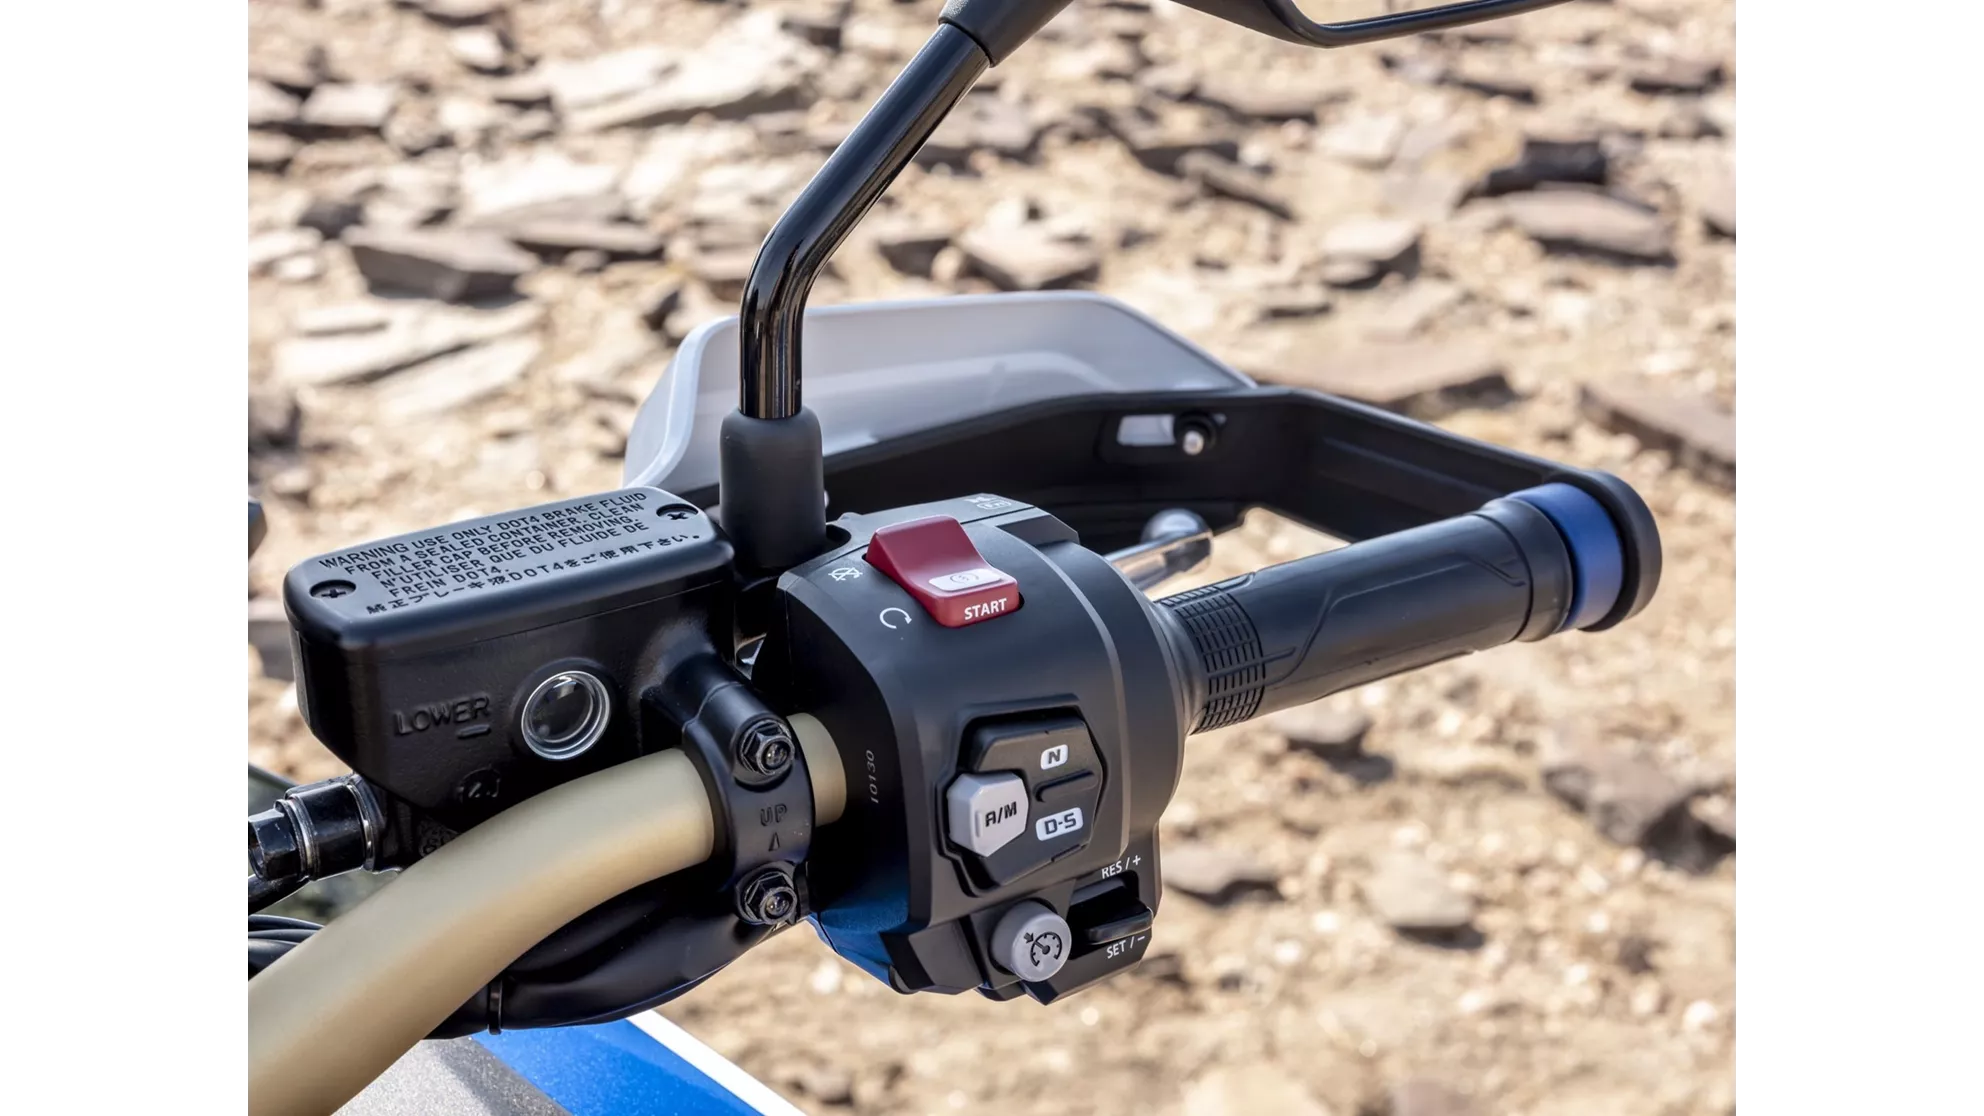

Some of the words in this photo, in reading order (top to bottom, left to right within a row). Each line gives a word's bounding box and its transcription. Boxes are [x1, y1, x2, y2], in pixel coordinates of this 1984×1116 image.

[319, 543, 409, 568] WARNING
[412, 535, 448, 549] USE
[452, 525, 492, 540] ONLY
[497, 515, 540, 530] DOT4
[542, 503, 598, 520] BRAKE
[599, 492, 647, 508] FLUID
[344, 558, 396, 575] FROM
[400, 555, 412, 563] A
[415, 538, 485, 559] SEALED
[589, 503, 645, 520] CLEAN
[371, 560, 437, 579] FILLER
[440, 551, 473, 564] CAP
[477, 534, 547, 555] BEFORE
[548, 515, 639, 540] REMOVING.
[380, 560, 485, 589] N'UTILISER
[489, 549, 527, 563] QUE
[529, 543, 555, 554] DU
[558, 528, 622, 548] FLUIDE
[624, 522, 649, 533] DE
[389, 579, 447, 598] FREIN
[452, 566, 509, 583] DOT4.
[964, 598, 1007, 620] START
[394, 696, 490, 736] LOWER
[1048, 749, 1061, 764] N
[866, 750, 879, 804] 10130
[760, 803, 788, 826] UP
[985, 801, 1017, 827] A/M
[1044, 812, 1076, 835] D-S
[1102, 860, 1122, 879] RES
[1106, 940, 1126, 959] SET
